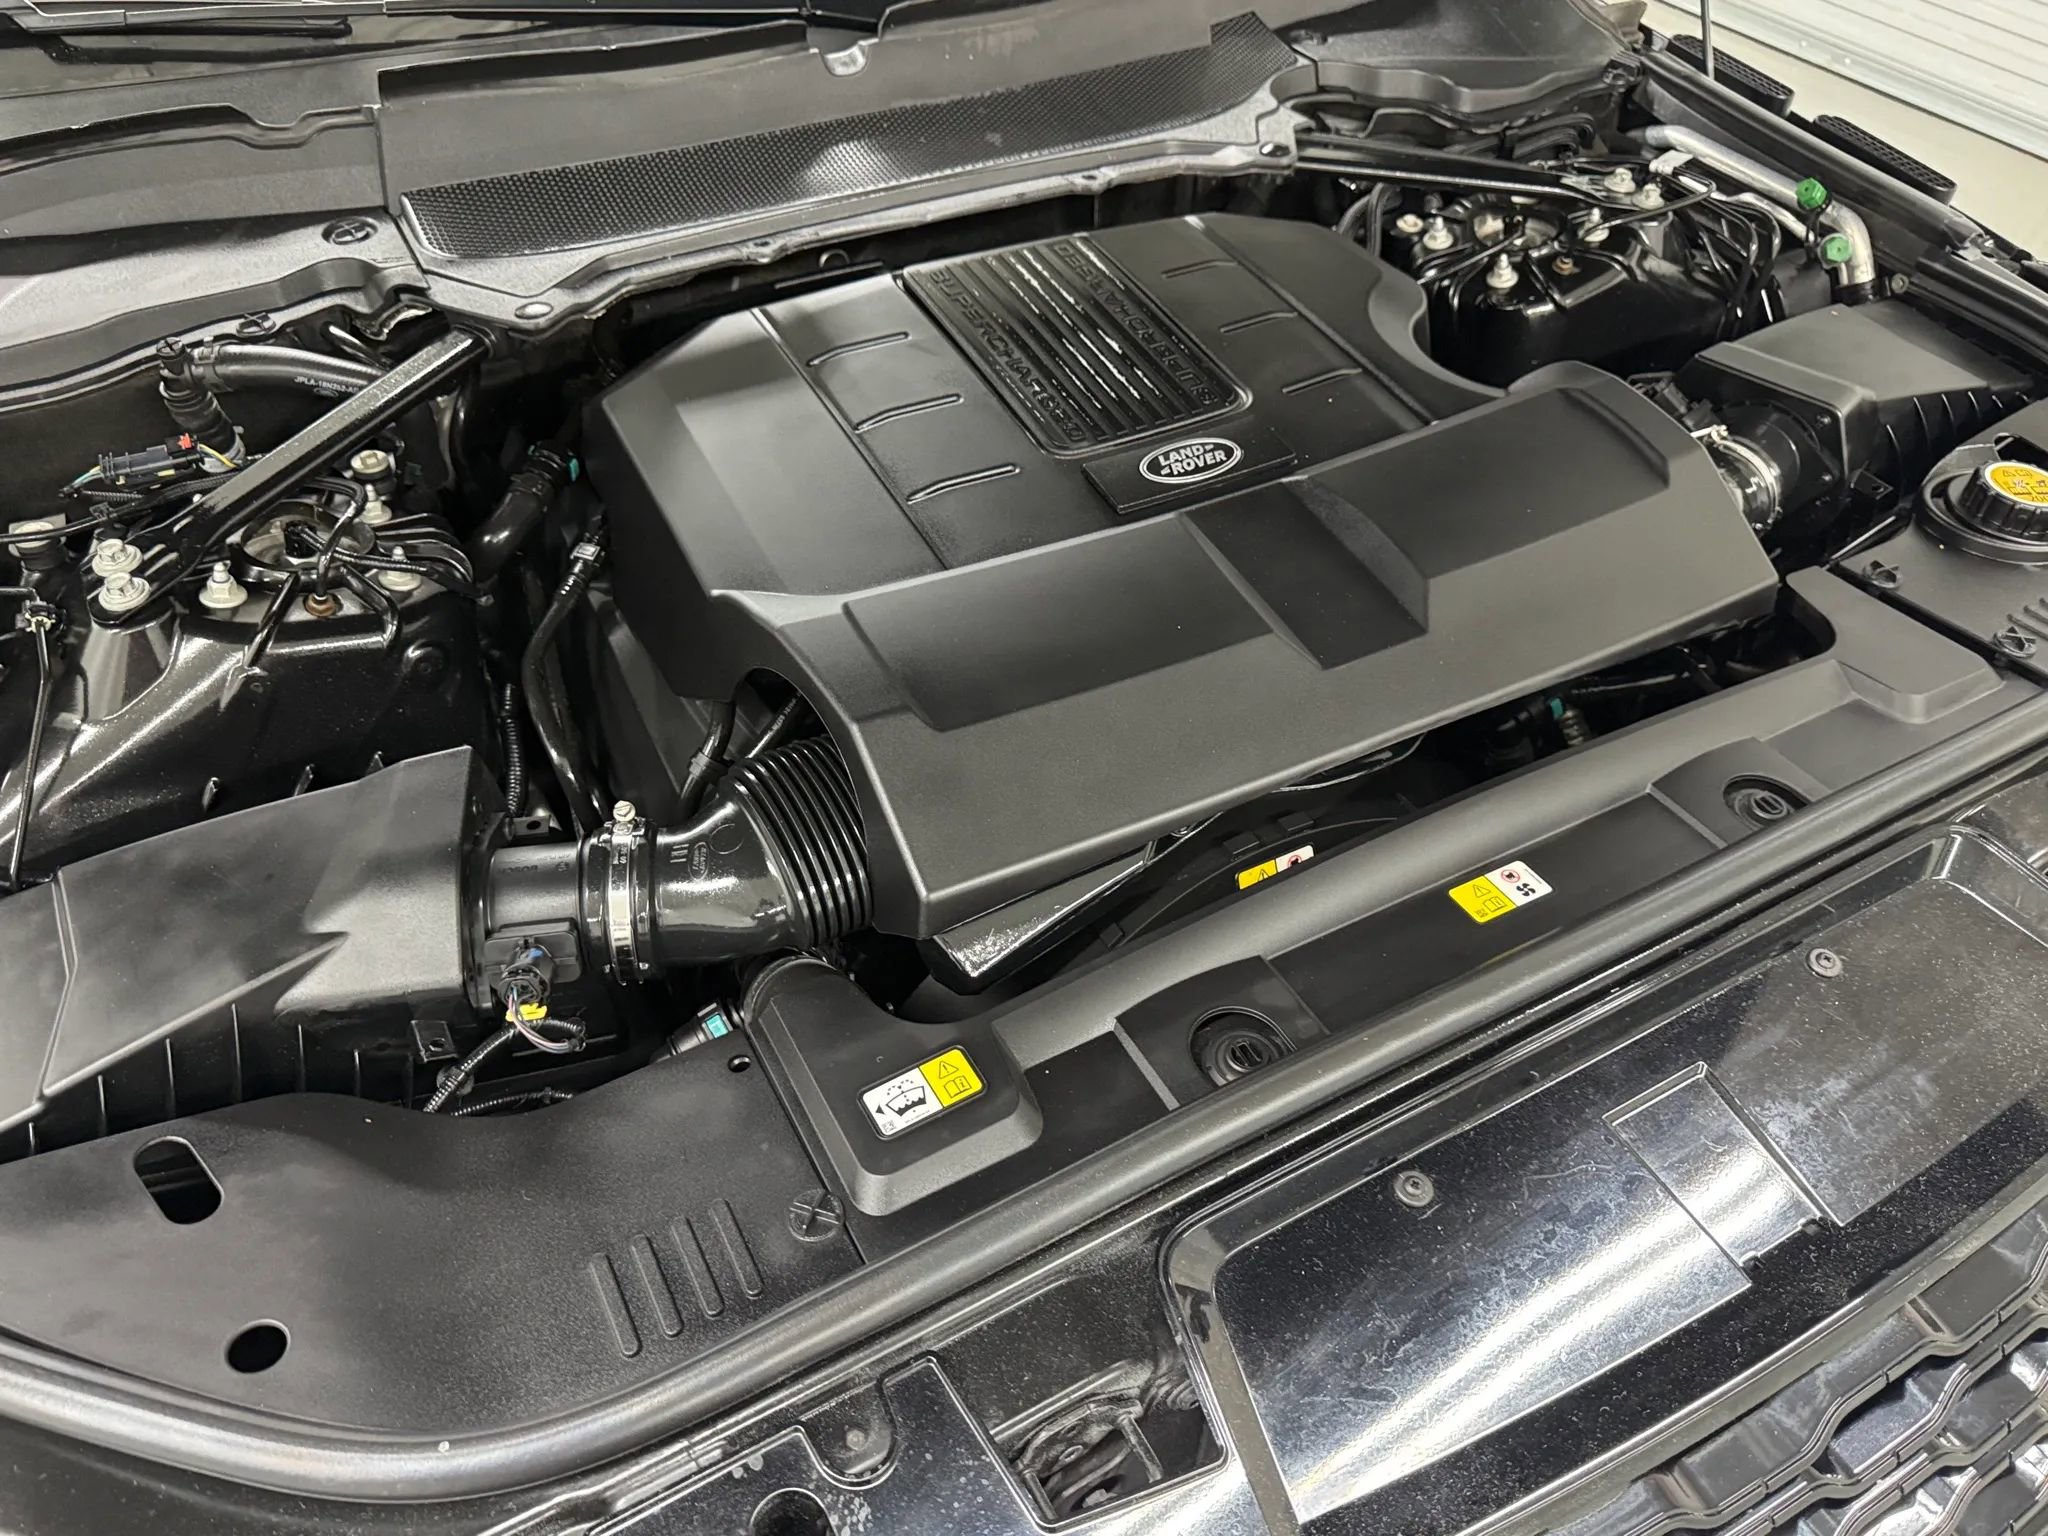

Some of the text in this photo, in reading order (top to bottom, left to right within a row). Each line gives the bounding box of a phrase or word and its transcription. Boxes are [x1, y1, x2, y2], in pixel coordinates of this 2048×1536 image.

[928, 269, 1086, 441] SUPERCHARGED
[1158, 444, 1204, 466] LAND
[1170, 450, 1227, 475] ROVER
